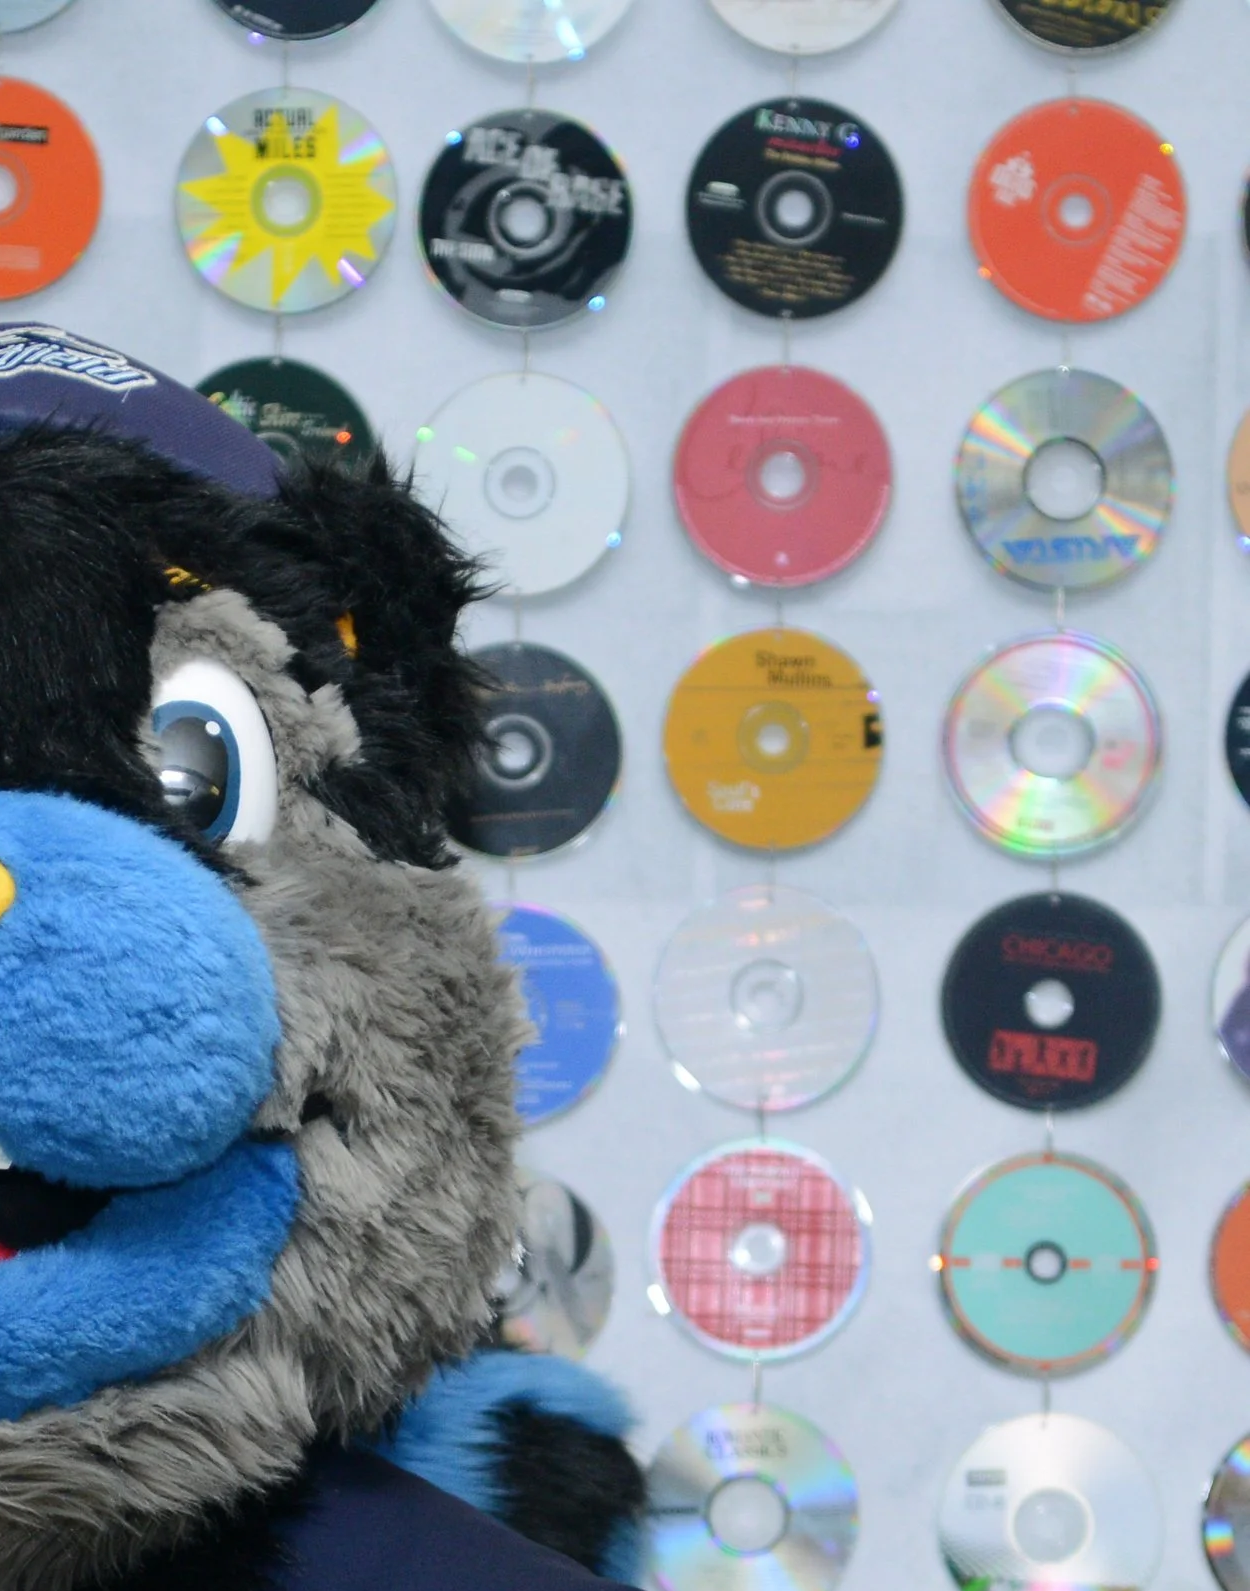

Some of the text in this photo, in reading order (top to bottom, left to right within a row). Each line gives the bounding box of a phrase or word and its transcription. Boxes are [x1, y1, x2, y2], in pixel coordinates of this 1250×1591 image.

[754, 108, 834, 138] KENNY
[462, 127, 523, 167] ACE
[755, 650, 816, 669] Shawn
[1002, 934, 1114, 970] CHICAGO
